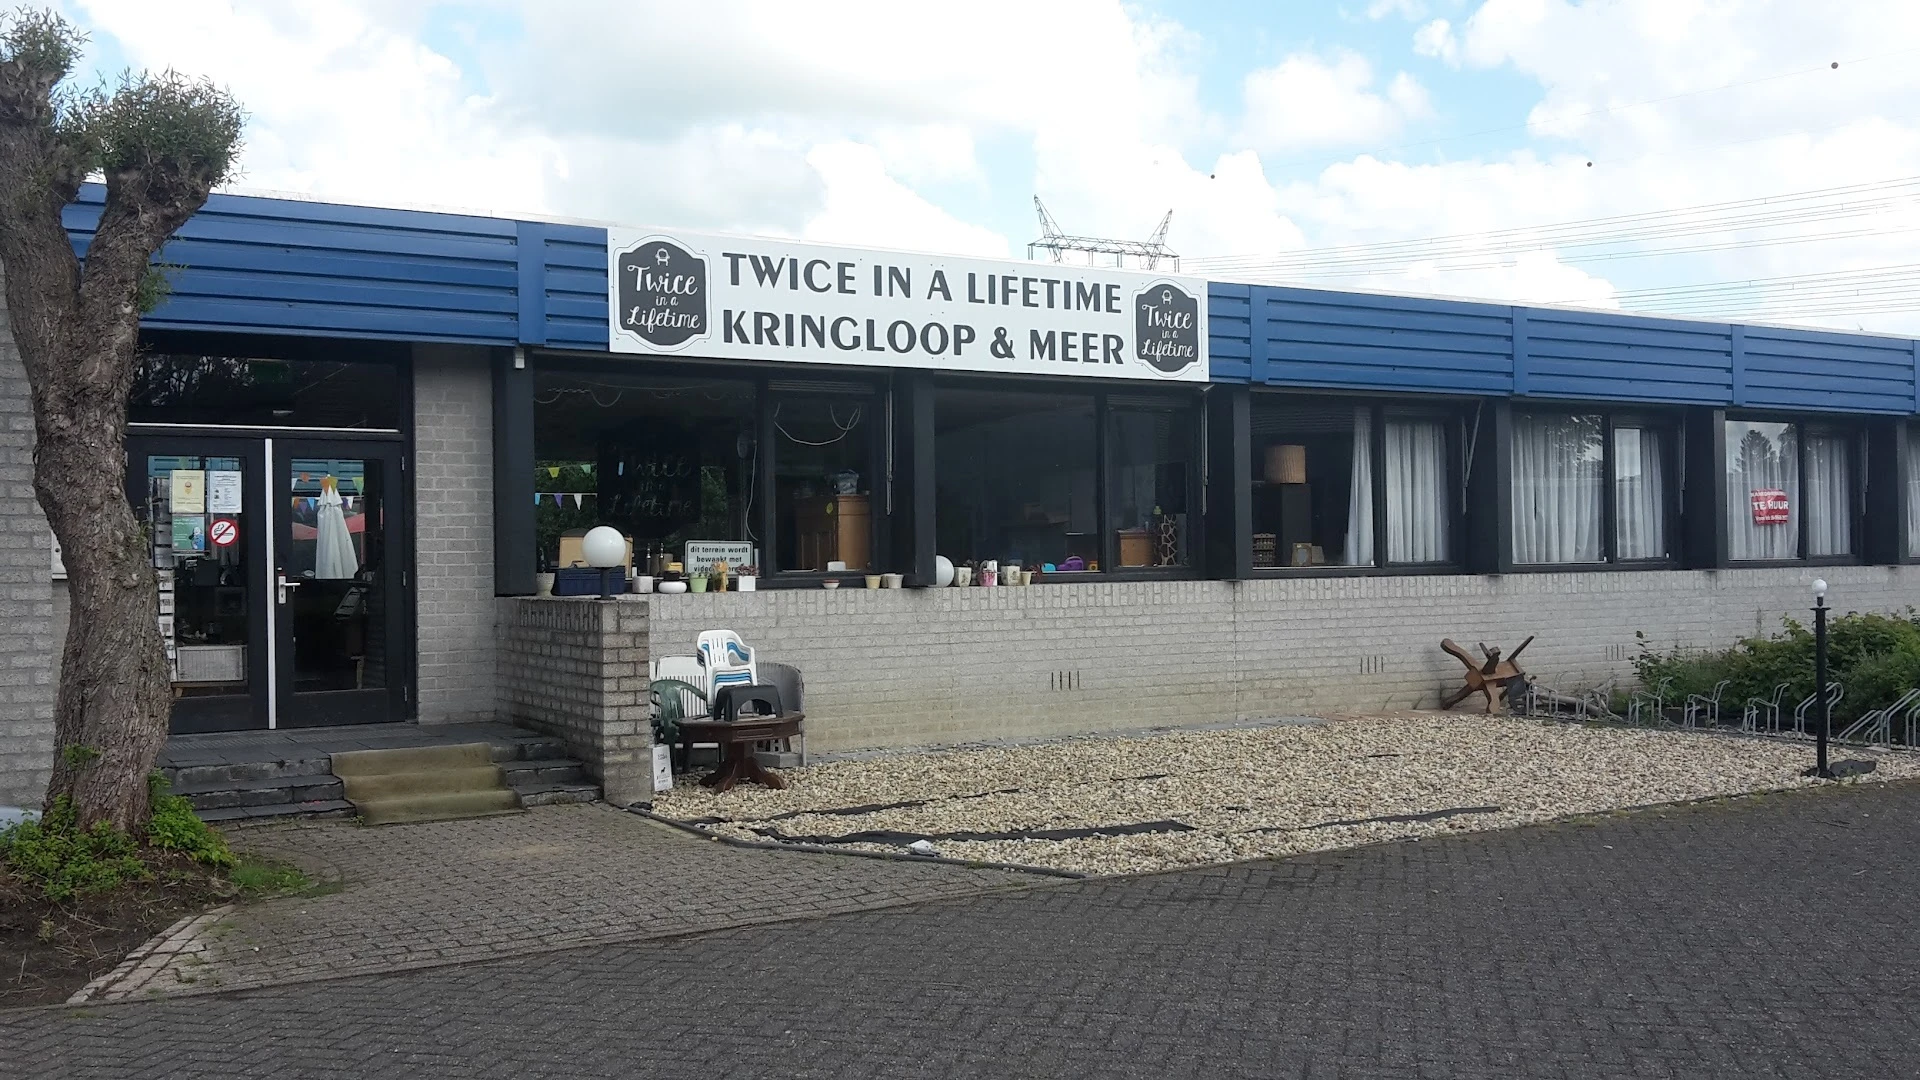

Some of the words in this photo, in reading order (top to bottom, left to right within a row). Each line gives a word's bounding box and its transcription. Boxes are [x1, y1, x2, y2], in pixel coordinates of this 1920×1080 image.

[627, 265, 698, 295] Twice
[722, 253, 857, 294] TWICE
[873, 265, 911, 298] IN
[926, 270, 953, 301] A
[968, 273, 1122, 313] LIFETIME
[655, 296, 667, 306] in
[670, 297, 678, 306] a
[627, 306, 700, 333] Lifetime
[1141, 304, 1192, 329] Twice
[723, 310, 976, 356] KRINGLOOP
[989, 327, 1016, 359] &
[1029, 330, 1124, 364] MEER
[1161, 330, 1171, 339] in
[1172, 330, 1178, 339] a
[1141, 339, 1194, 362] Lifetime
[1753, 502, 1766, 511] TE
[1767, 501, 1789, 510] HUUR
[690, 545, 700, 553] dit
